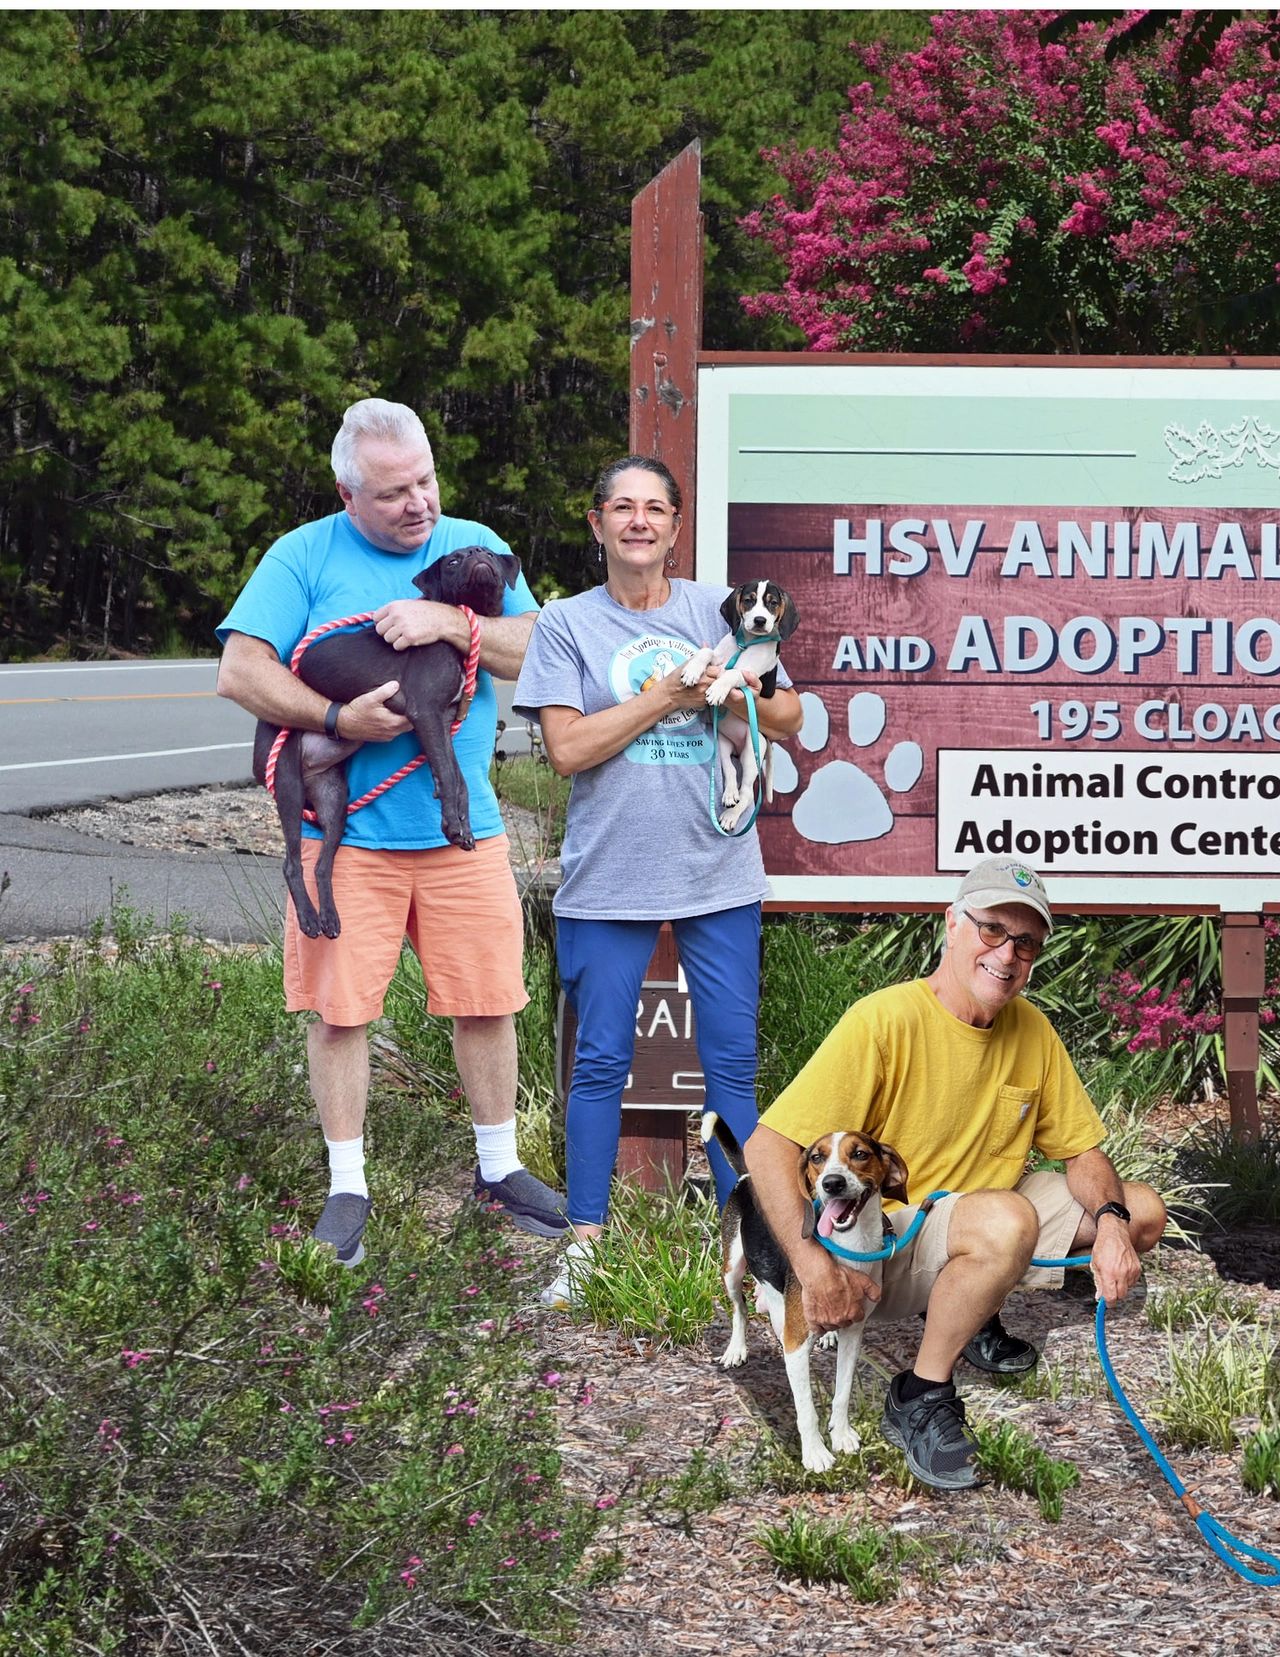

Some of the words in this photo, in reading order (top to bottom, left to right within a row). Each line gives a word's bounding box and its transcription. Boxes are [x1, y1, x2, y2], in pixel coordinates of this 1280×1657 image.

[832, 517, 987, 579] HSV
[831, 634, 936, 674] AND
[1029, 699, 1122, 741] 195
[635, 738, 665, 747] SAVING
[686, 738, 704, 748] FOR
[650, 748, 666, 761] 30
[668, 751, 690, 759] YEARS
[970, 762, 1124, 798] Animal
[954, 819, 1158, 863] Adoption
[634, 998, 693, 1040] RAI
